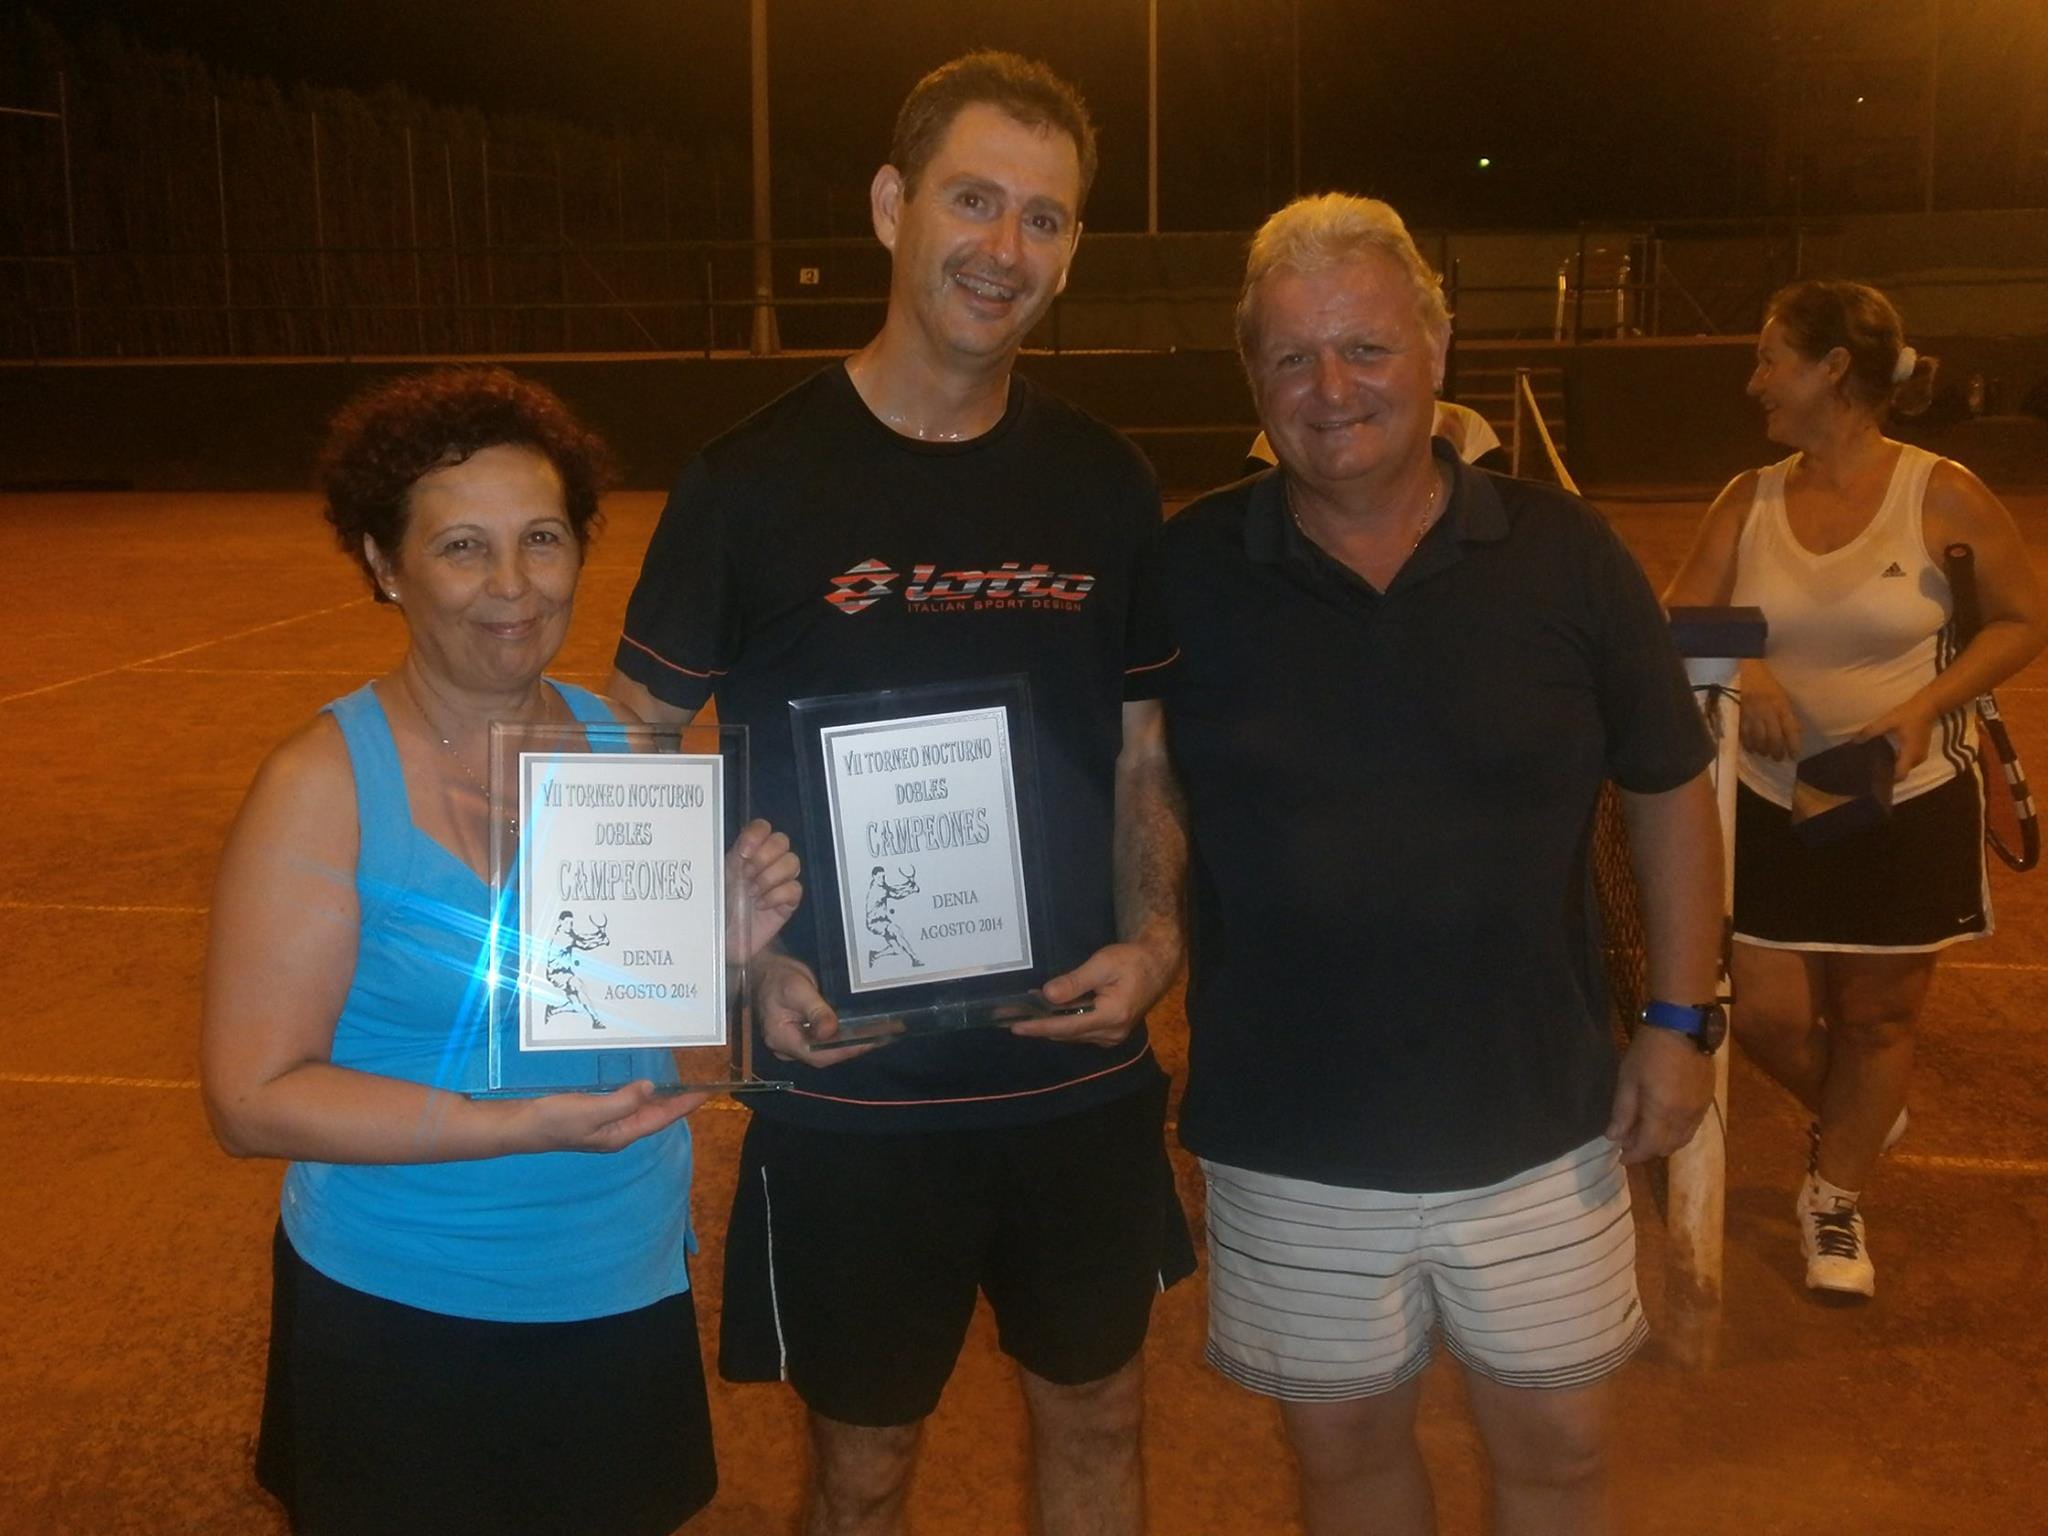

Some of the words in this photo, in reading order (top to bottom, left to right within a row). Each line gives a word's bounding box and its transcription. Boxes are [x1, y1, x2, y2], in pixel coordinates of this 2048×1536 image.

[907, 602, 967, 613] ITALIAN
[973, 599, 1026, 610] SPORT
[1032, 599, 1082, 612] DESIGN
[842, 750, 863, 776] VII
[864, 746, 920, 773] TORNEO
[922, 737, 992, 767] NOCTURNO
[542, 779, 563, 808] VII
[565, 783, 626, 808] TORNEO
[628, 783, 705, 809] NOCTURNO
[895, 777, 949, 805] DOBLES
[594, 822, 653, 846] DOBLES
[866, 807, 990, 858] CAMPEONES
[558, 859, 693, 901] CAMPEONES
[932, 890, 979, 909] DENIA
[920, 920, 976, 941] AGOSTO
[979, 917, 1003, 933] 2014
[623, 949, 674, 967] DENIA
[604, 983, 667, 1000] AGOSTO
[670, 983, 698, 999] 2014
